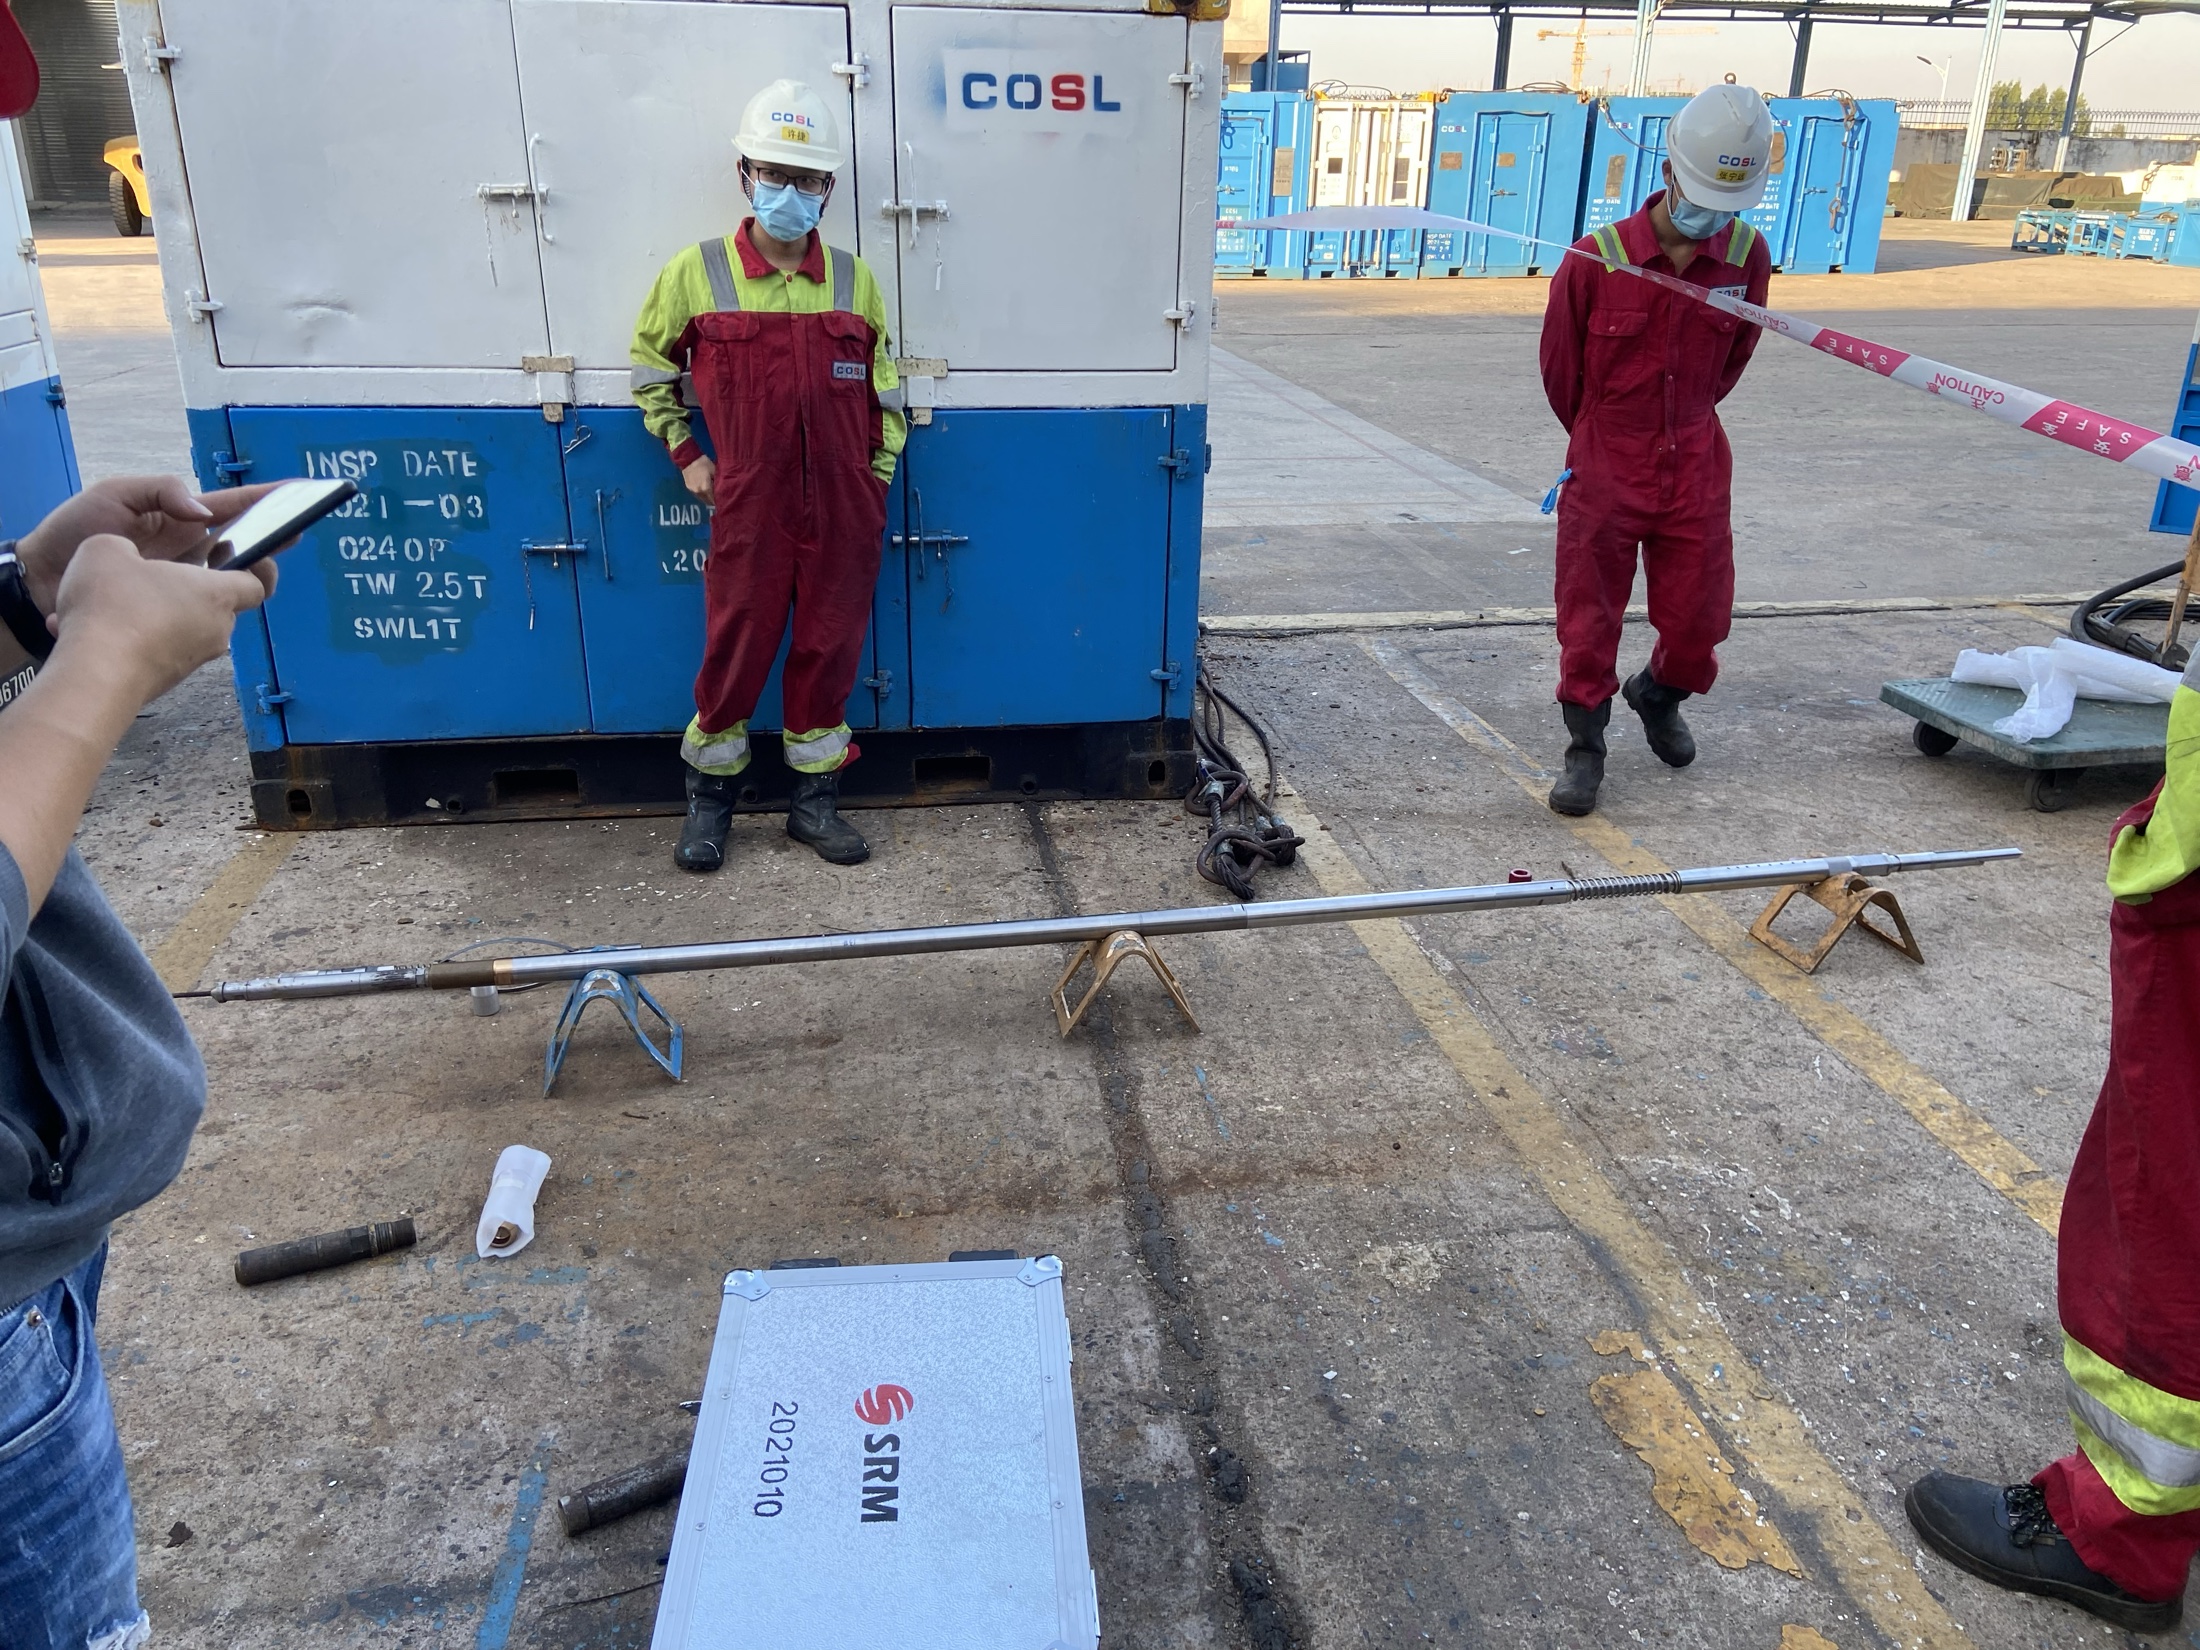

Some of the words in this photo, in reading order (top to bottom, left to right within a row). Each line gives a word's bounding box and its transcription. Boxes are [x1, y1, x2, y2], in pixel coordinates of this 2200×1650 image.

[962, 72, 1121, 112] COSL
[771, 112, 815, 128] COSL
[1441, 125, 1467, 133] COSL
[1718, 154, 1757, 167] COSL
[1829, 337, 1888, 366] SAFE
[836, 366, 865, 377] COSL
[1934, 372, 2005, 405] CAUTION
[2055, 411, 2132, 445] SAFE
[305, 450, 378, 481] INSP
[402, 450, 478, 477] DATE
[659, 504, 702, 527] LOAD
[344, 573, 396, 596] TW
[754, 1401, 799, 1517] 2021010
[860, 1433, 901, 1523] SRM
